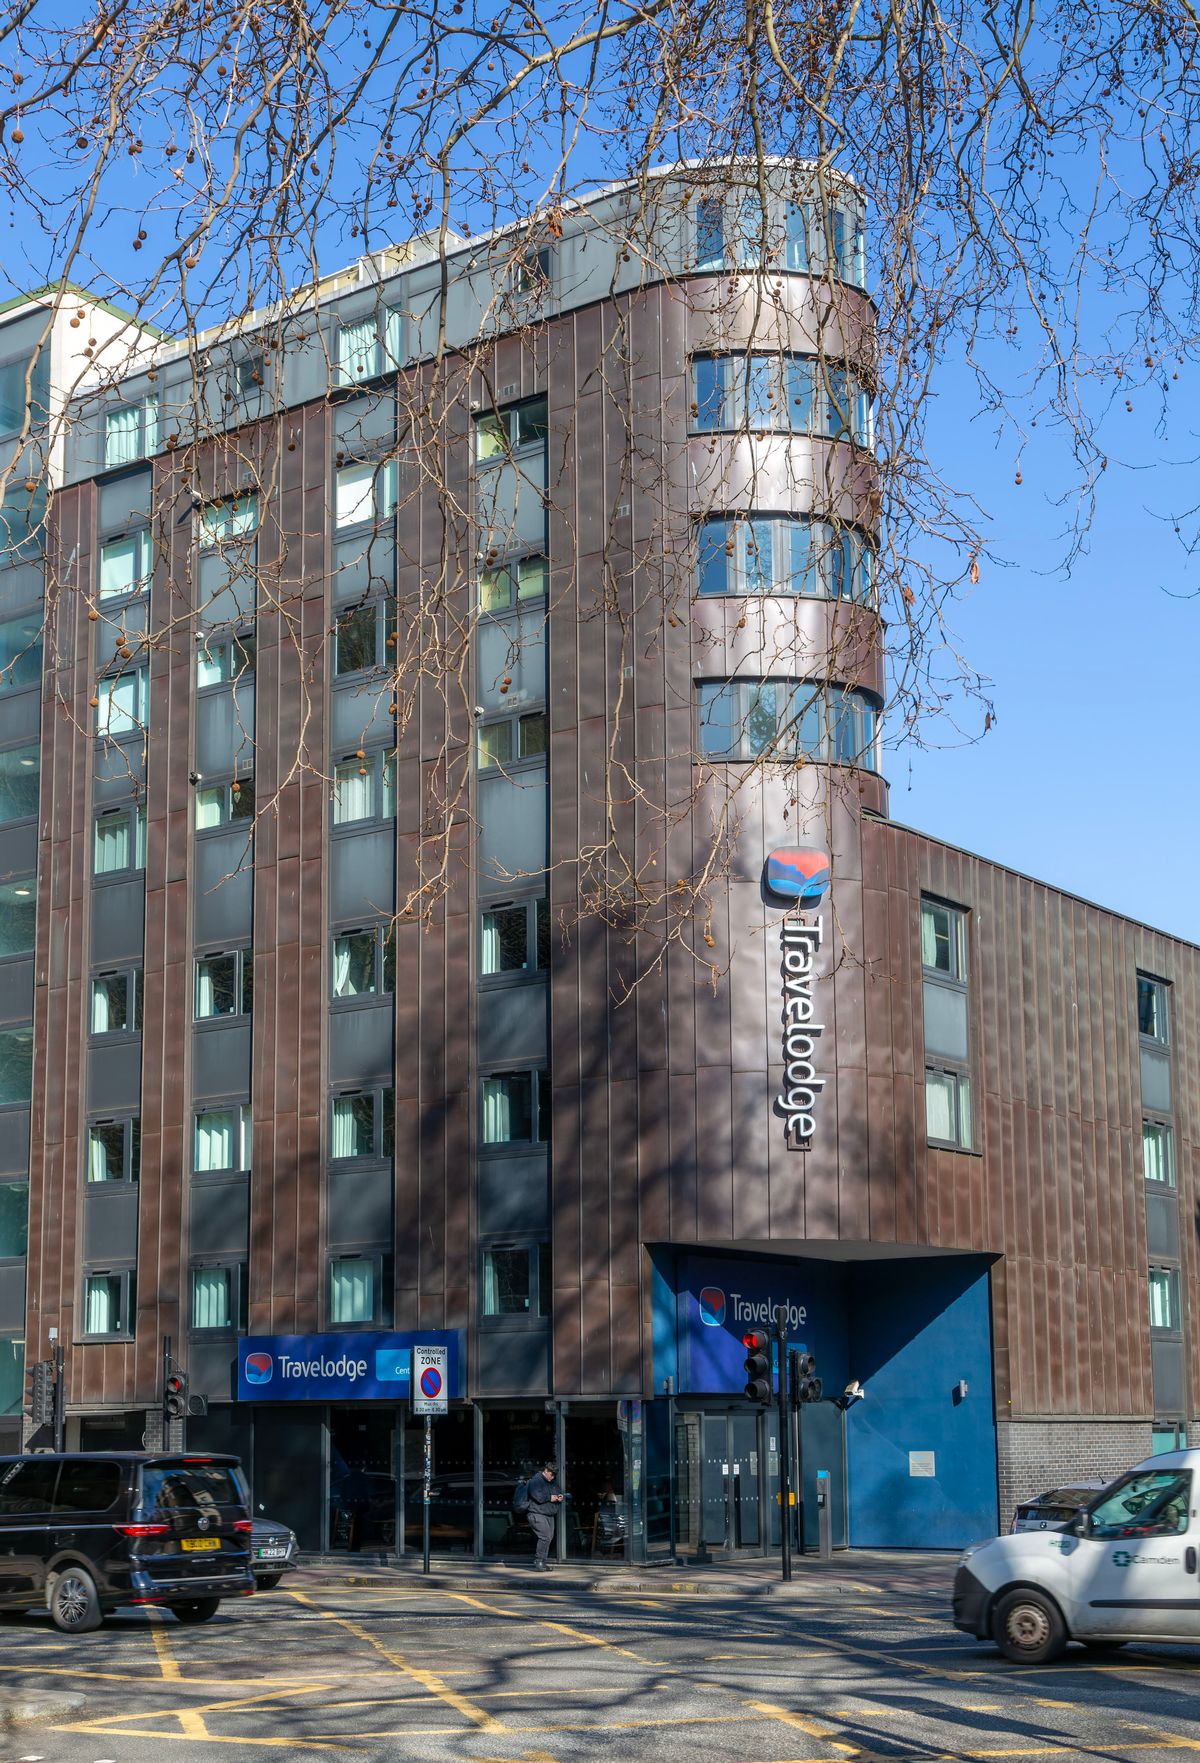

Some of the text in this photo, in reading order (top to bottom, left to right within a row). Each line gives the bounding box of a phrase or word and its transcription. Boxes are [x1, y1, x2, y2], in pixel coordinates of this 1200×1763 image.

[778, 915, 826, 1137] Travelodge
[730, 1293, 807, 1331] Travelodge
[278, 1354, 368, 1382] Travelodge
[420, 1356, 441, 1365] ZONE
[395, 1366, 410, 1375] Cent
[1132, 1554, 1181, 1565] Camden
